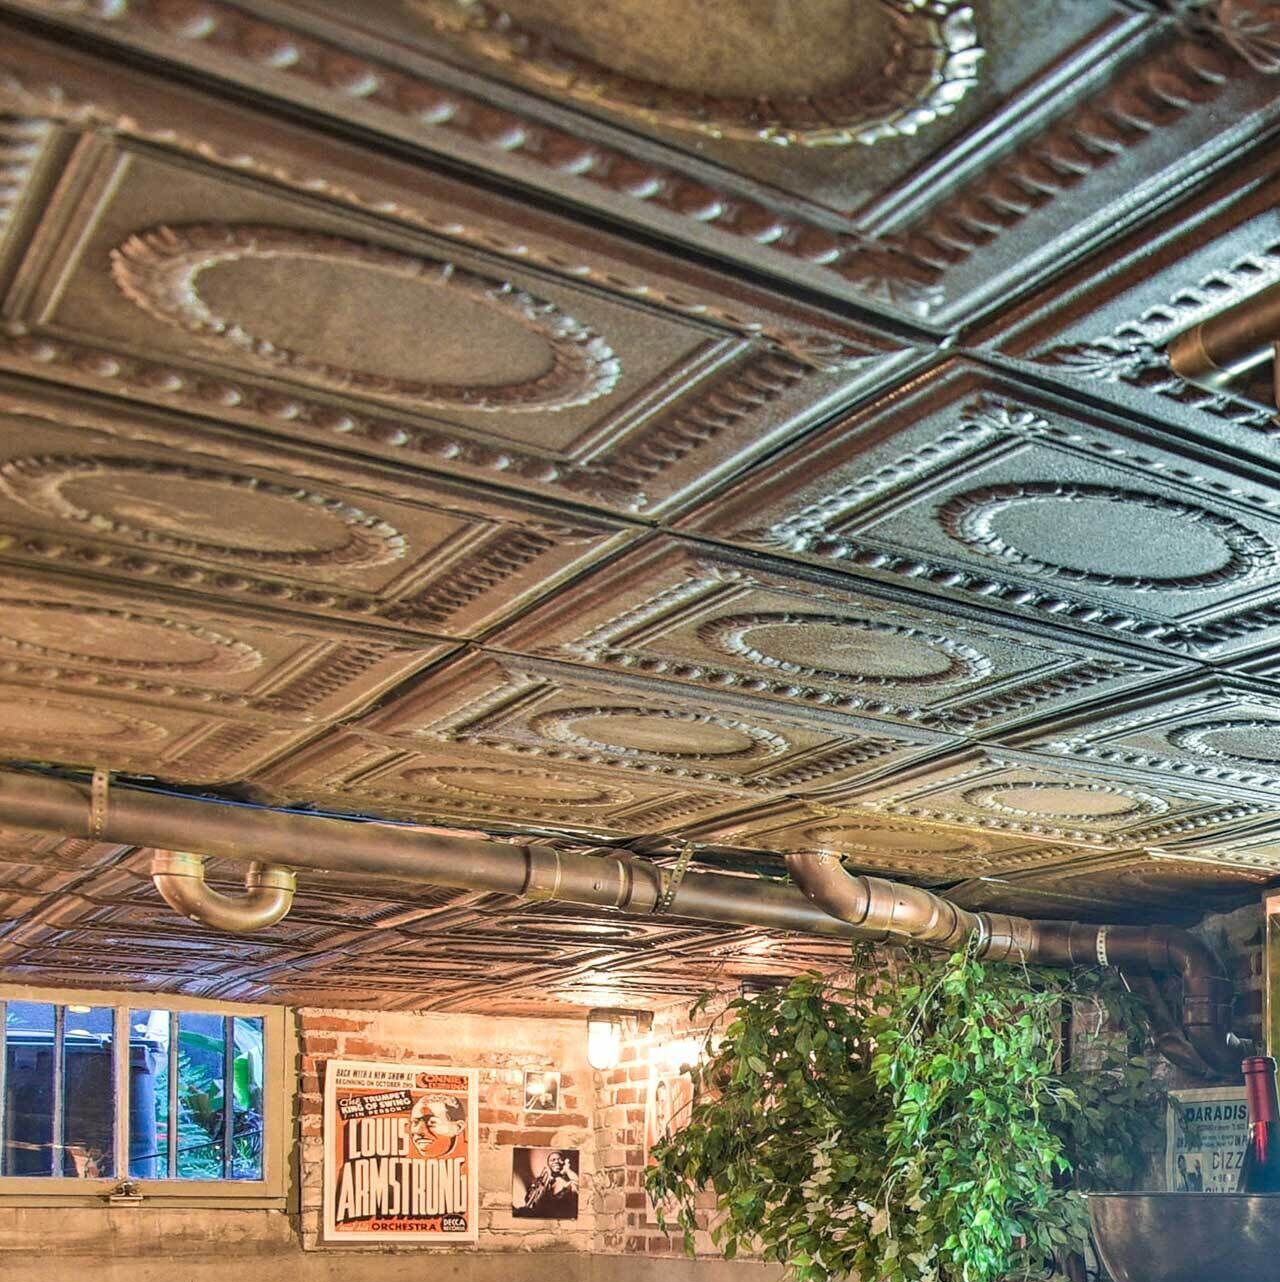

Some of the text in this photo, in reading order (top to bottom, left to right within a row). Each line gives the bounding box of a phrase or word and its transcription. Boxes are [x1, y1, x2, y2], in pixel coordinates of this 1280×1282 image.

[336, 1068, 351, 1078] BACK
[376, 1080, 401, 1088] OCTOBER
[363, 1091, 406, 1103] TRUMPET
[341, 1097, 412, 1115] KING OF SWING
[348, 1117, 410, 1160] LOUIS
[336, 1156, 467, 1222] ARMSTRONG
[371, 1222, 437, 1232] ORCHESTRA
[443, 1218, 466, 1226] DECCA
